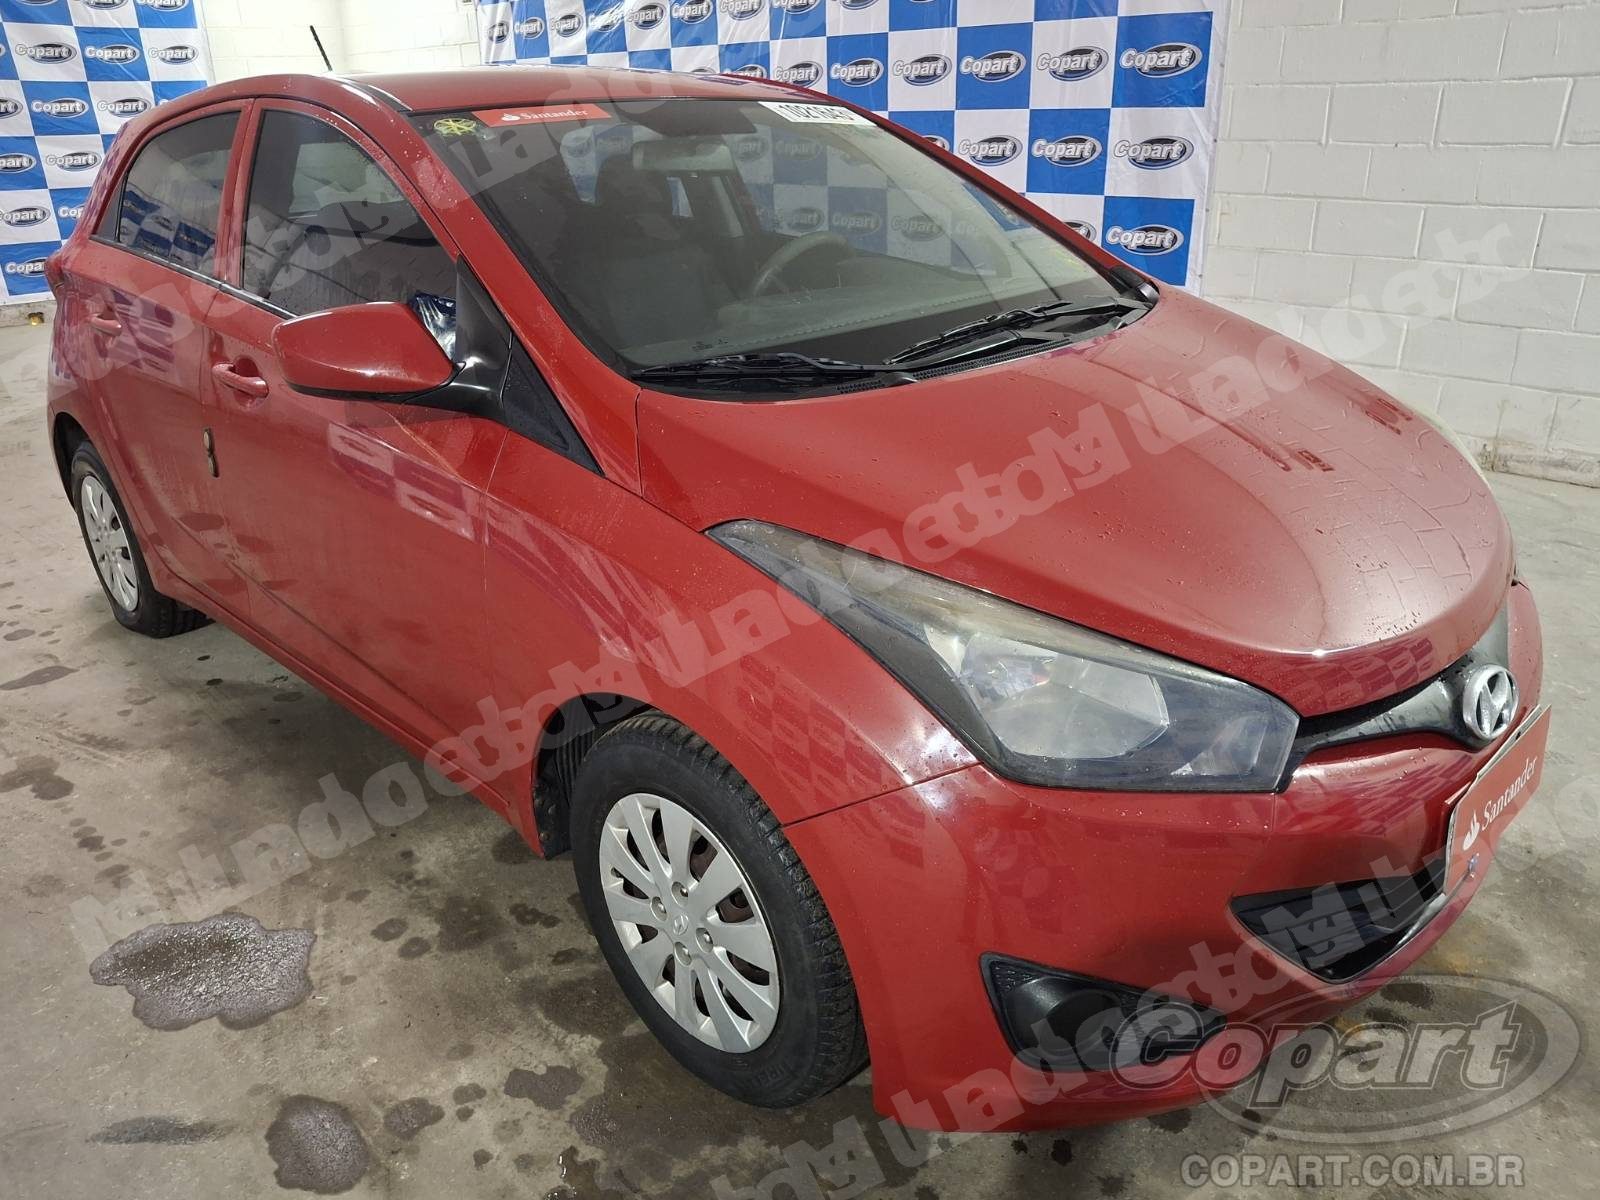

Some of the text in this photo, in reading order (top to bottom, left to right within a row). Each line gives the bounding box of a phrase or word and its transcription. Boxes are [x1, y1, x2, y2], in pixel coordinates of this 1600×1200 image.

[627, 6, 664, 23] Copart
[673, 2, 709, 19] Copart
[15, 43, 71, 58] Copart
[84, 45, 136, 60] Copart
[148, 47, 194, 60] Copart
[1120, 47, 1193, 70] Copart
[892, 59, 943, 79] Copart
[959, 53, 1019, 75] Copart
[1036, 50, 1104, 73] Copart
[774, 64, 818, 83] Copart
[830, 64, 877, 81] Copart
[31, 100, 82, 115] Copart
[97, 99, 146, 113] Copart
[520, 109, 588, 120] Santander
[959, 137, 1018, 158] Copart
[1031, 138, 1093, 160] Copart
[1113, 139, 1184, 160] Copart
[46, 153, 96, 168] Copart
[1106, 226, 1174, 249] Copart
[5, 261, 45, 275] Copa
[1482, 755, 1538, 832] Santander
